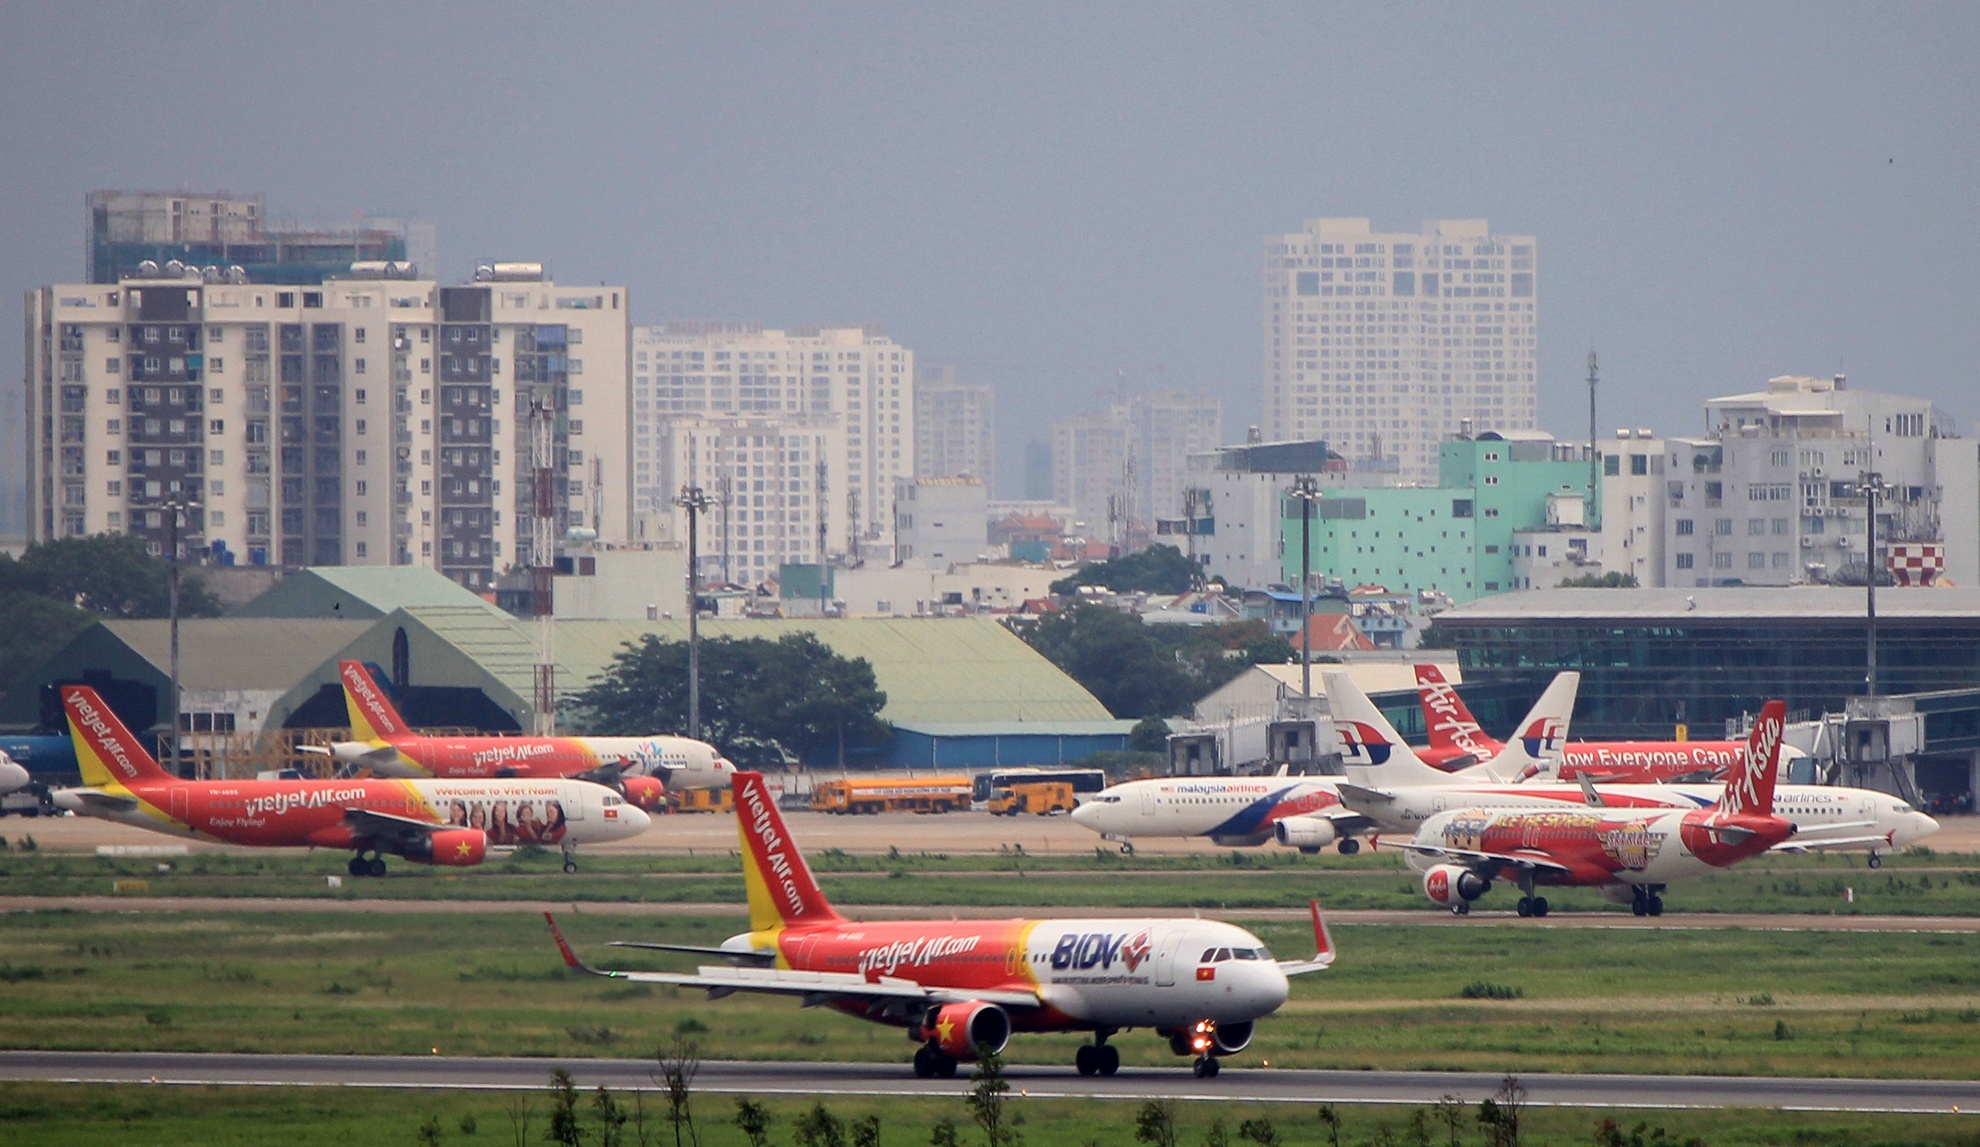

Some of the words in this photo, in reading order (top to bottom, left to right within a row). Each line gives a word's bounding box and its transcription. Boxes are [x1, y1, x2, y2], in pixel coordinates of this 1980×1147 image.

[1597, 749, 1688, 769] Everyone
[1693, 749, 1730, 766] Can
[435, 787, 486, 796] Welcome
[489, 787, 500, 796] to
[503, 787, 526, 796] Viet
[528, 787, 558, 796] Nam!
[1783, 794, 1832, 803] airlines
[209, 817, 234, 828] Enjoy
[236, 817, 266, 829] Flying!
[1051, 932, 1129, 970] BIDV
